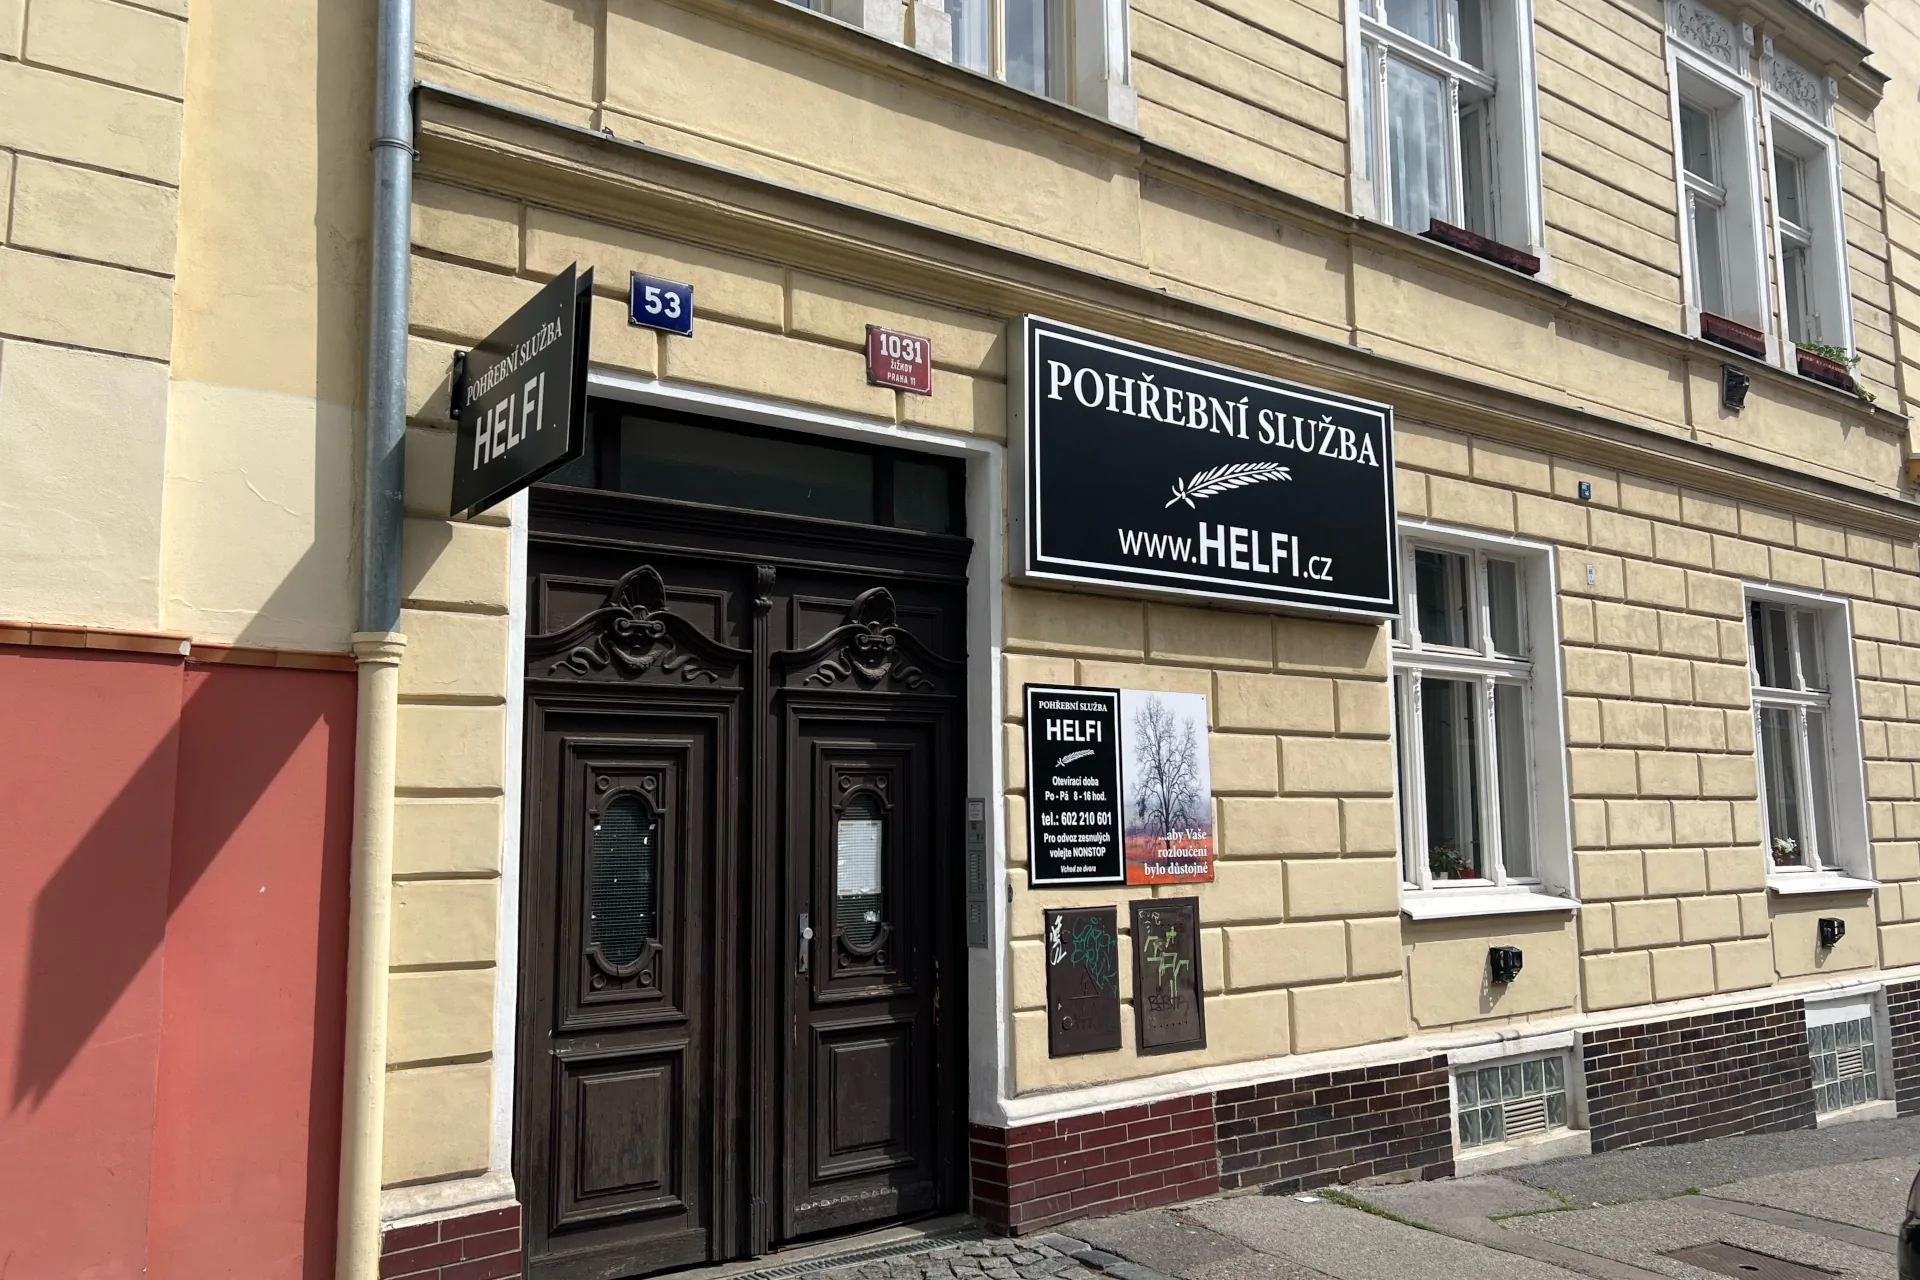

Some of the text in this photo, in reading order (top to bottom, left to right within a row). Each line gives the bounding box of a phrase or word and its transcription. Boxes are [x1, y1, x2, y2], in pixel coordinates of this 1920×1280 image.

[645, 286, 681, 318] 53
[880, 333, 922, 364] 1031
[466, 316, 562, 406] POHŘEBNÍ SLUŽBA
[890, 359, 912, 373] ŽIŽKOV
[887, 372, 916, 386] PRAHA 11
[1047, 359, 1379, 467] POHŘEBNÍ SLUŽBA
[473, 371, 545, 471] HELFI
[1118, 521, 1333, 582] www.HELFI.cz
[1038, 700, 1107, 712] POHŘEBNÍ SLUŽBA
[1046, 718, 1102, 742] HELFI
[1082, 776, 1099, 786] doba
[1045, 790, 1055, 801] Po
[1060, 790, 1069, 801] Pá
[1073, 791, 1078, 801] 8
[1083, 791, 1091, 801] 16
[1092, 791, 1107, 801] hod.
[1041, 811, 1112, 826] tel.: 602 210 601
[1043, 831, 1111, 845] Pro odvoz zesnulých
[1185, 828, 1207, 840] Vaše
[1049, 846, 1106, 860] volejte NONSTOP
[1158, 845, 1207, 858] rozloučení
[1060, 865, 1076, 873] Vchod
[1083, 864, 1096, 872] dvora
[1144, 862, 1208, 878] bylo důstojné
